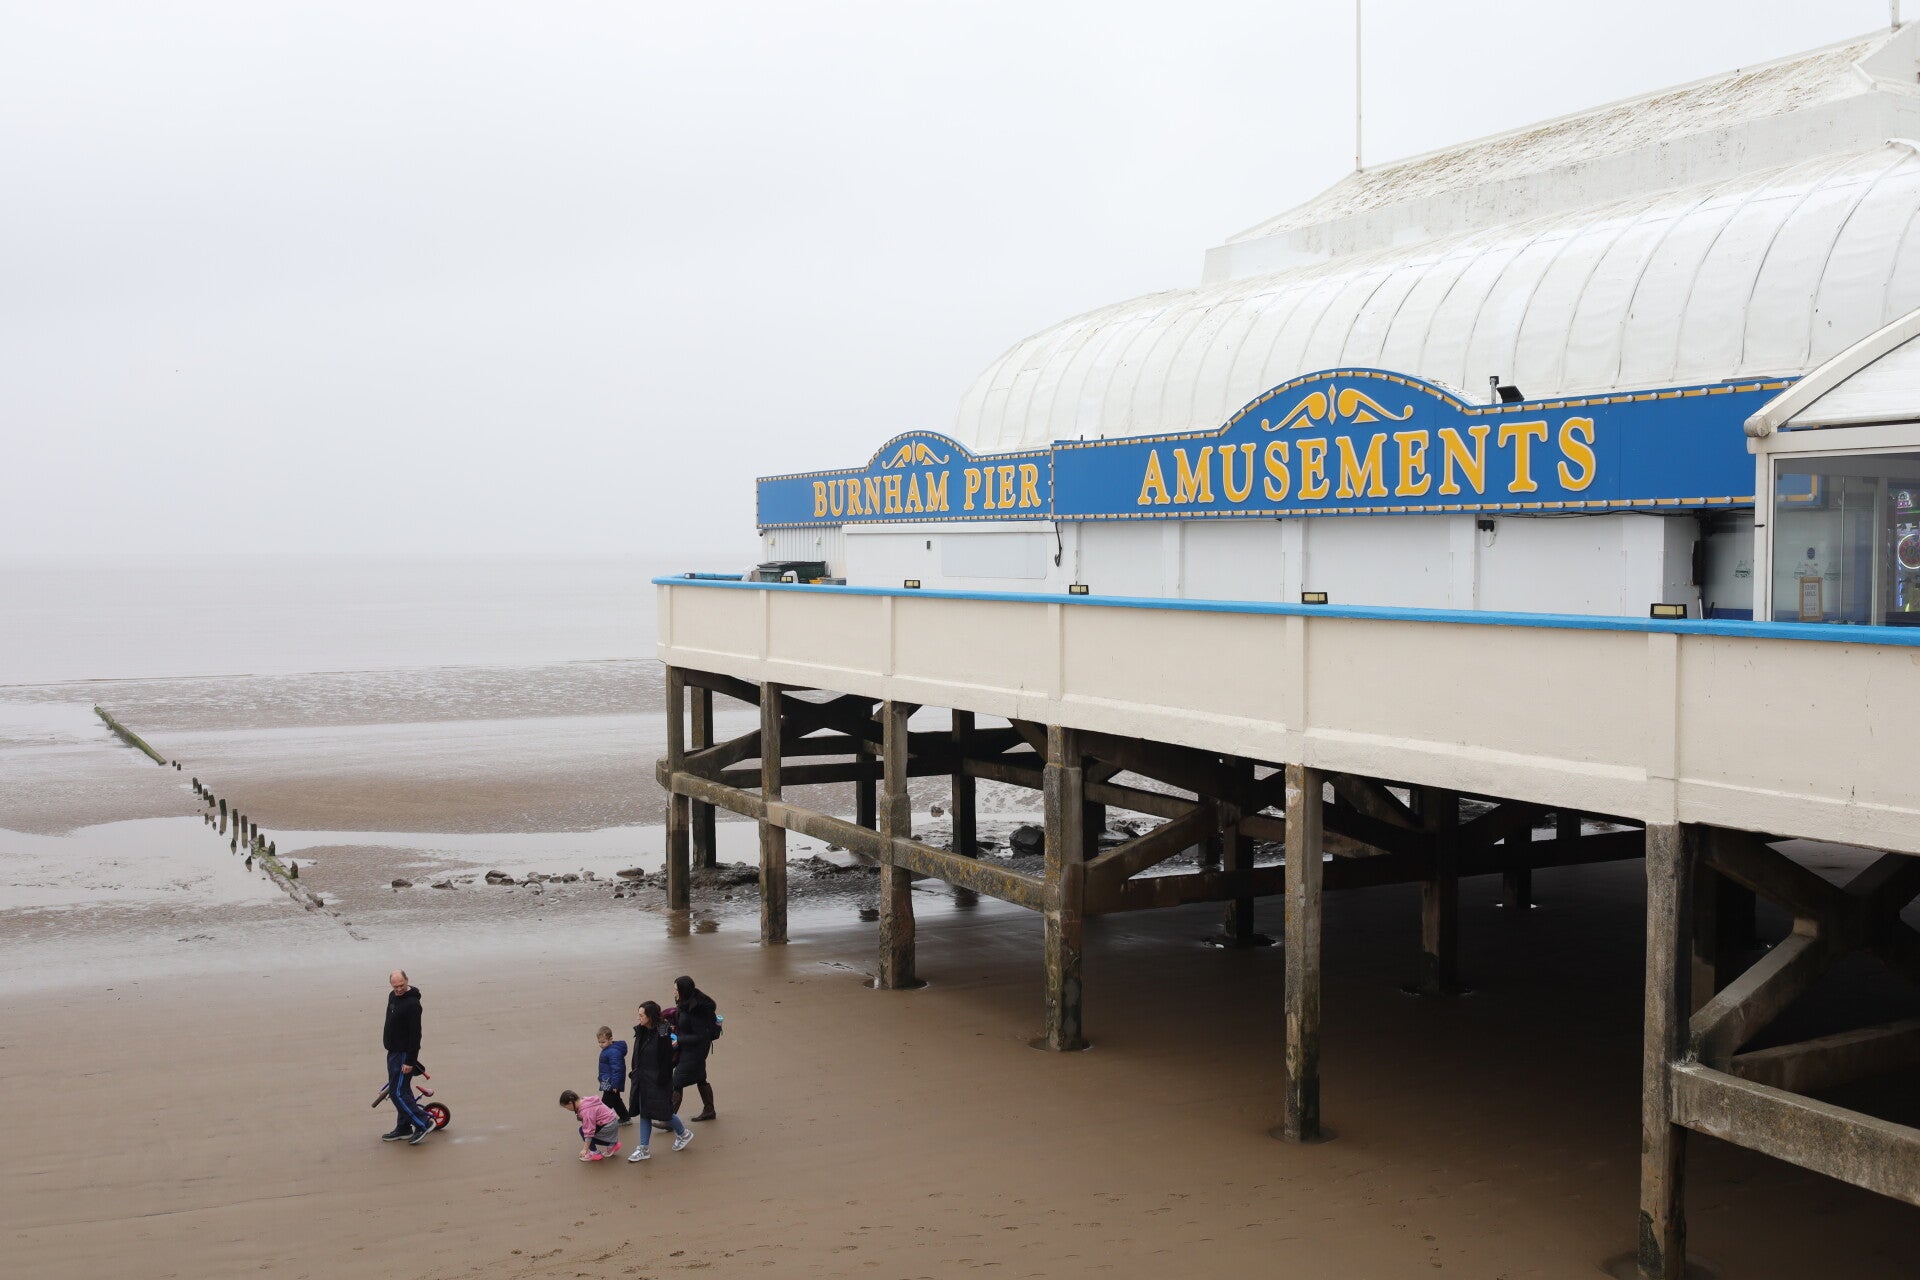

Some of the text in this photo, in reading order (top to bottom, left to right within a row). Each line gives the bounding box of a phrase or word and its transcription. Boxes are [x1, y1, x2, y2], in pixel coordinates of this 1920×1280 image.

[813, 463, 1042, 518] BURNHAM PIER
[1137, 416, 1597, 506] AMUSEMENTS
